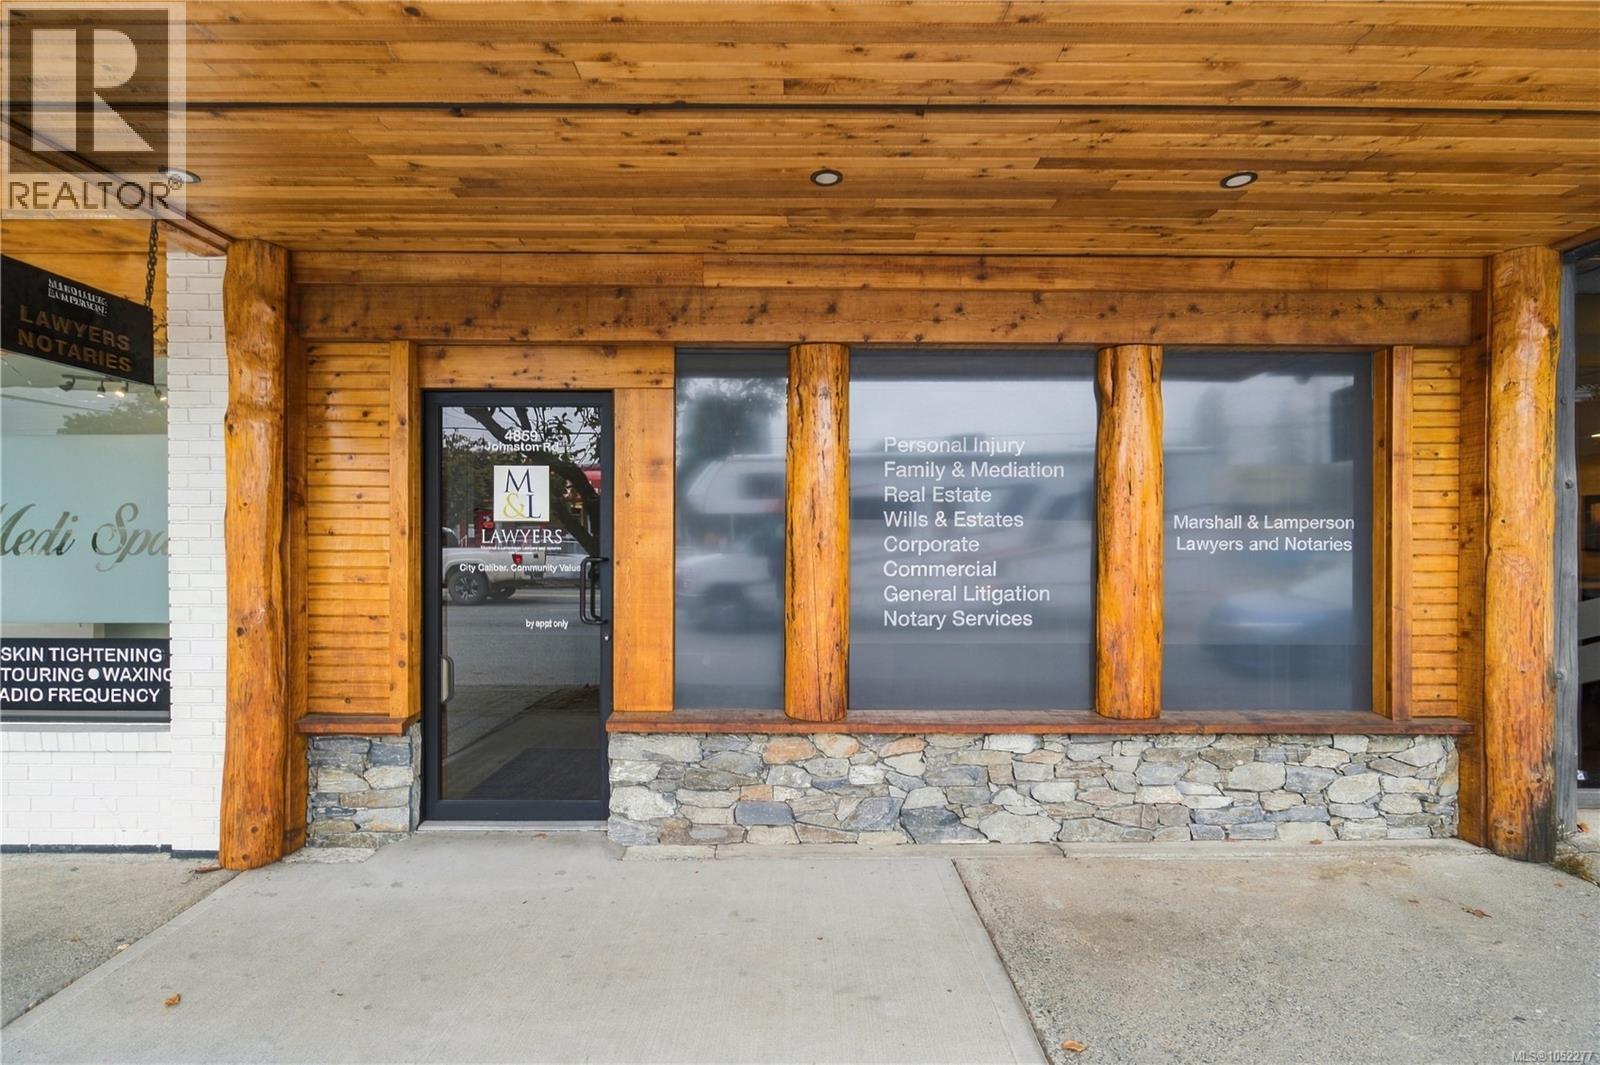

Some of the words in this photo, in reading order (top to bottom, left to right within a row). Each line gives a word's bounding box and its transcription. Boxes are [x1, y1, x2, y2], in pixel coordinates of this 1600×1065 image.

[20, 304, 131, 351] LAWYERS
[17, 328, 133, 373] NOTARIES
[484, 441, 541, 452] Johnston
[884, 437, 967, 453] Personal
[974, 437, 1025, 456] Injury
[884, 461, 946, 481] Family
[951, 461, 965, 478] &
[971, 461, 1065, 478] Mediation
[504, 468, 535, 493] M
[884, 486, 926, 502] Real
[932, 487, 992, 503] Estate
[503, 493, 527, 519] &
[527, 493, 541, 519] L
[883, 511, 929, 528] Wills
[934, 511, 948, 528] &
[954, 511, 1024, 528] Estates
[1173, 514, 1242, 530] Marshall
[1247, 514, 1259, 529] &
[1264, 515, 1355, 532] Lamperson
[91, 502, 168, 572] Spa
[481, 528, 563, 544] LAWYERS
[884, 536, 980, 555] Corporate
[1176, 537, 1244, 554] Lawyers
[1249, 537, 1279, 551] and
[1285, 537, 1353, 551] Notaries
[459, 563, 476, 573] City
[510, 563, 557, 573] Community
[883, 560, 997, 577] Commercial
[884, 585, 957, 602] General
[963, 585, 1050, 605] Litigation
[525, 619, 535, 629] by
[535, 620, 552, 629] appt
[553, 619, 569, 630] only
[884, 610, 946, 630] Notary
[952, 610, 1033, 627] Services
[1, 646, 44, 662] SKIN
[48, 647, 162, 662] TIGHTENING
[0, 667, 84, 682] TOURING
[0, 688, 43, 702] ADIO
[48, 688, 160, 703] FREQUENCY
